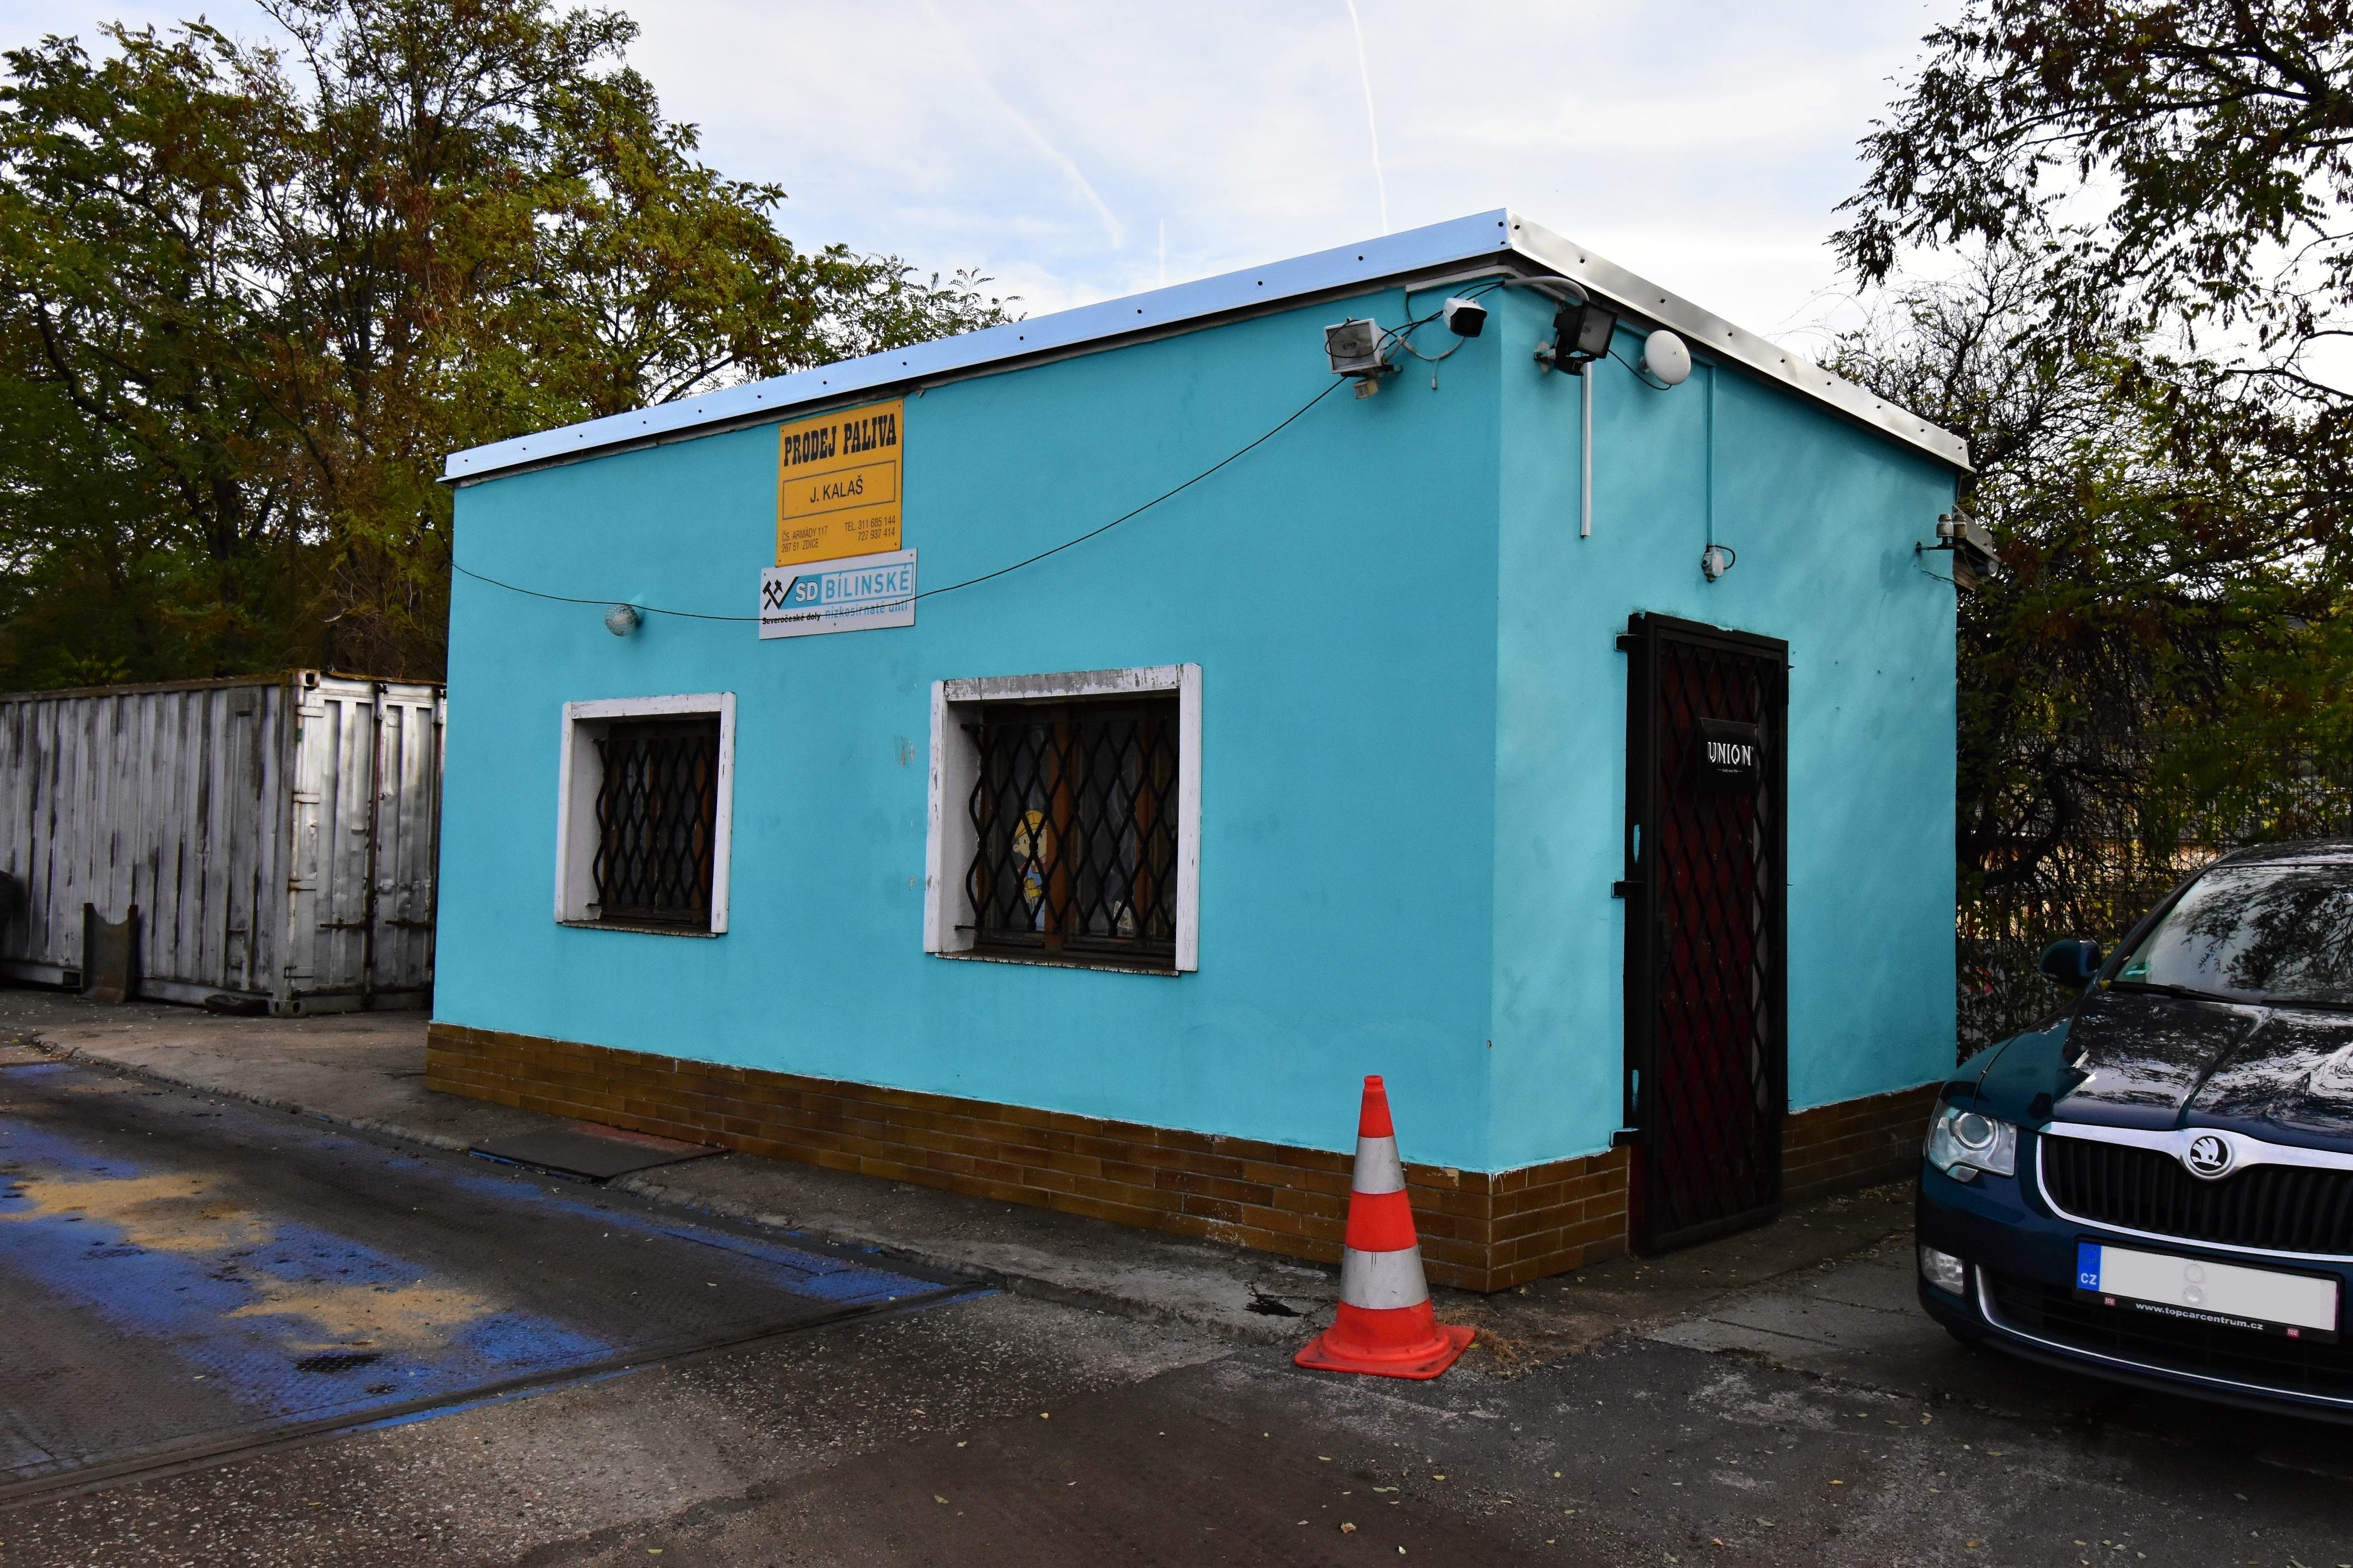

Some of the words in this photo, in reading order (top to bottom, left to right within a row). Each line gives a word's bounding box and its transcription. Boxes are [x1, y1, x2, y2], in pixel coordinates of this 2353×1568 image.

[784, 425, 837, 466] PRODEJ
[843, 413, 896, 455] PALIVA
[810, 487, 819, 503] J.
[823, 474, 864, 500] KALAŠ
[858, 519, 868, 529] 311
[871, 517, 882, 528] 685
[884, 515, 895, 525] 144
[792, 527, 816, 539] ARMÁDY
[818, 525, 828, 536] 117
[858, 531, 869, 541] 727
[871, 529, 882, 539] 937
[884, 527, 895, 537] 414
[782, 543, 791, 553] 267
[793, 542, 799, 551] 51
[802, 538, 819, 550] ZDICE
[795, 581, 818, 602] SD
[825, 565, 909, 599] BÍLINSKÉ
[806, 612, 821, 621] doly
[1707, 742, 1751, 766] UNION
[2081, 1273, 2097, 1285] CZ
[2136, 1303, 2264, 1330] www.topcarcentrum.cz
